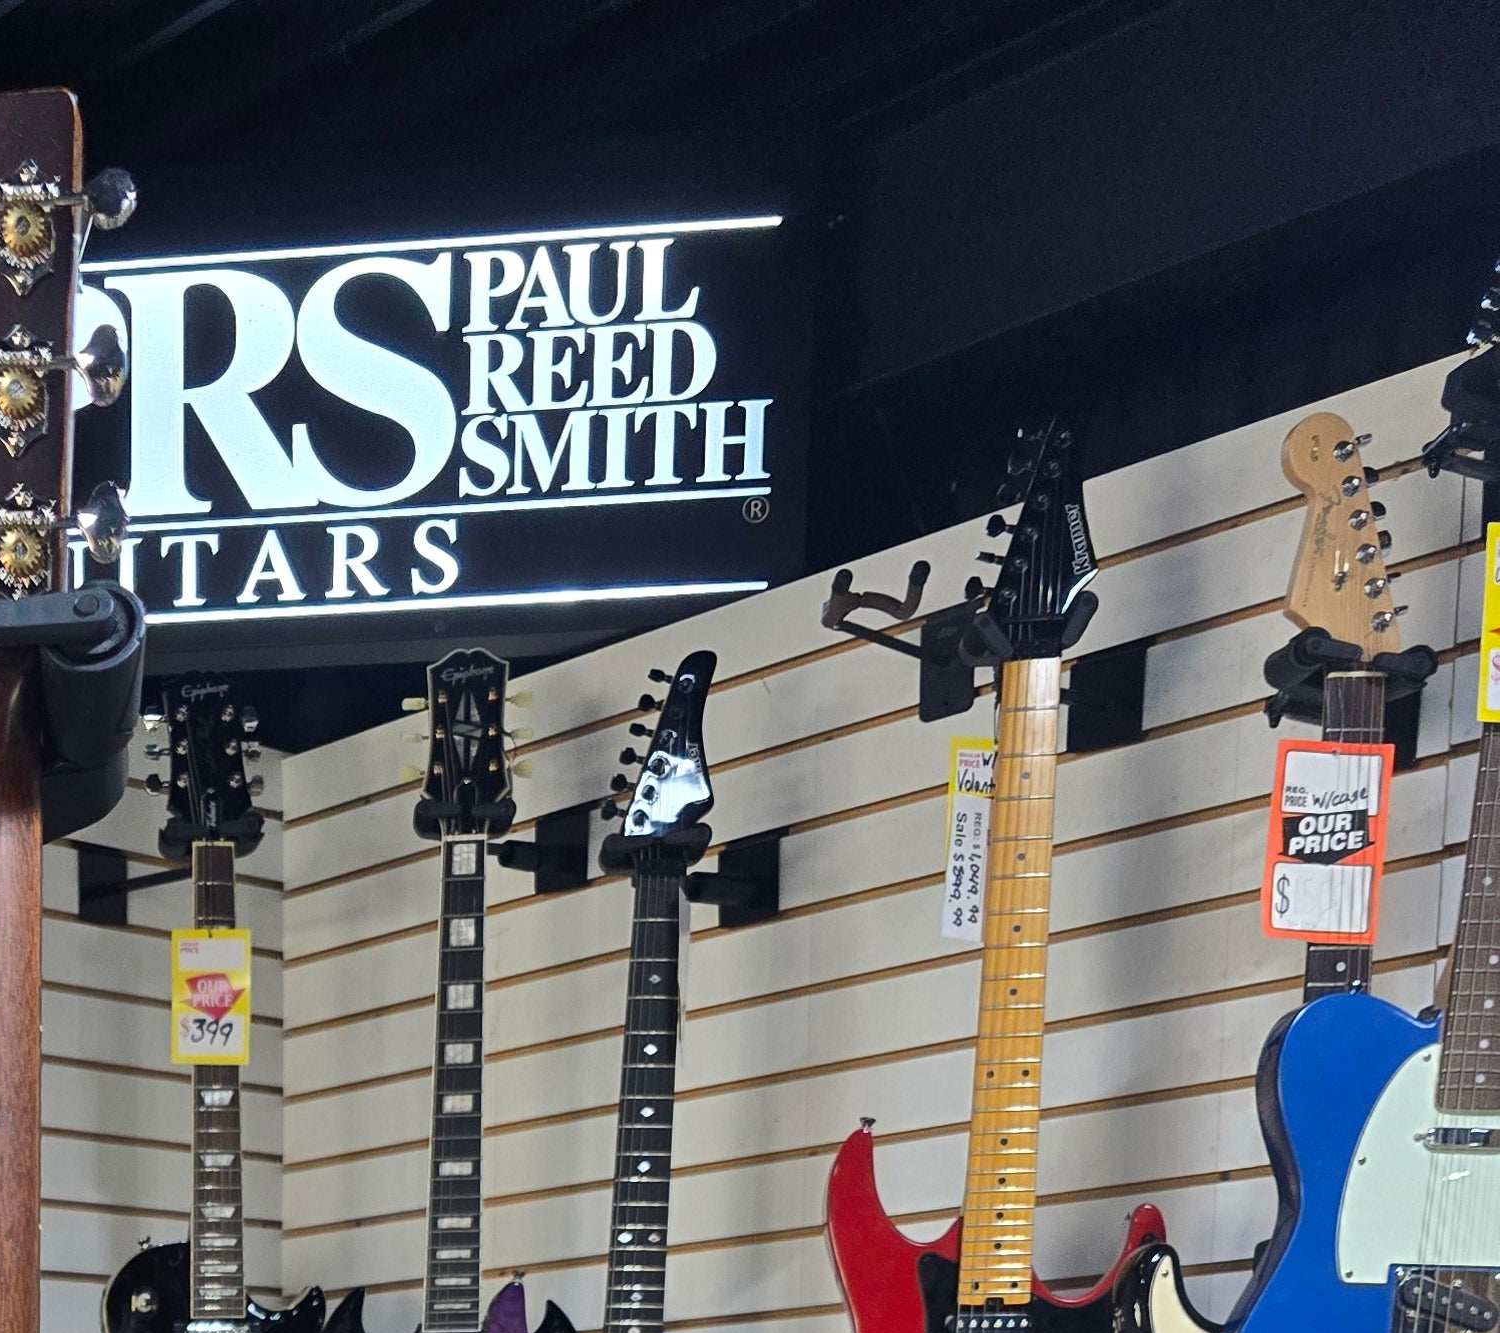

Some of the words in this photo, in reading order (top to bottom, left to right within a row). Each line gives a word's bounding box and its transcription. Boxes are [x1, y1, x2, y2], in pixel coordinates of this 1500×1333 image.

[462, 238, 701, 333] PAUL
[461, 321, 718, 416] REED
[458, 398, 776, 500] SMITH
[1064, 503, 1092, 576] Kramer
[67, 518, 460, 608] ITARS
[440, 664, 495, 687] Epiphone
[181, 682, 230, 703] Epiphone
[1284, 795, 1308, 808] PRICE
[954, 812, 968, 848] Sale
[1298, 813, 1353, 837] OUR
[1288, 831, 1365, 856] PRICE
[196, 979, 231, 993] OUR
[192, 993, 234, 1009] PRICE
